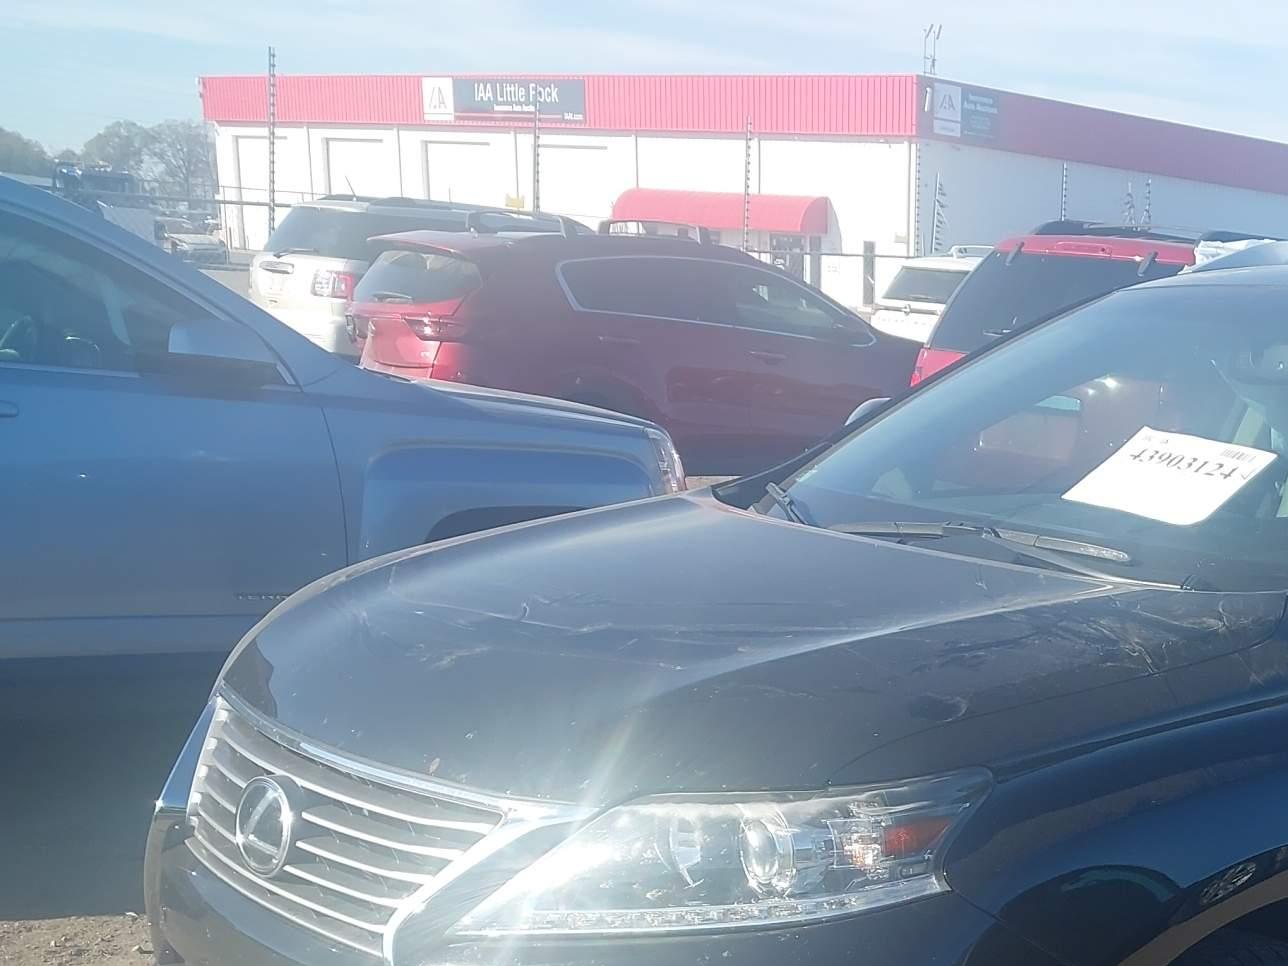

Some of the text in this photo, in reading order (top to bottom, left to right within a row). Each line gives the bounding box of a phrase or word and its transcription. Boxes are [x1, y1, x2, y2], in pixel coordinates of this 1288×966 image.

[475, 82, 494, 101] IAA
[496, 82, 526, 102] Little
[1130, 448, 1240, 480] 43903124
